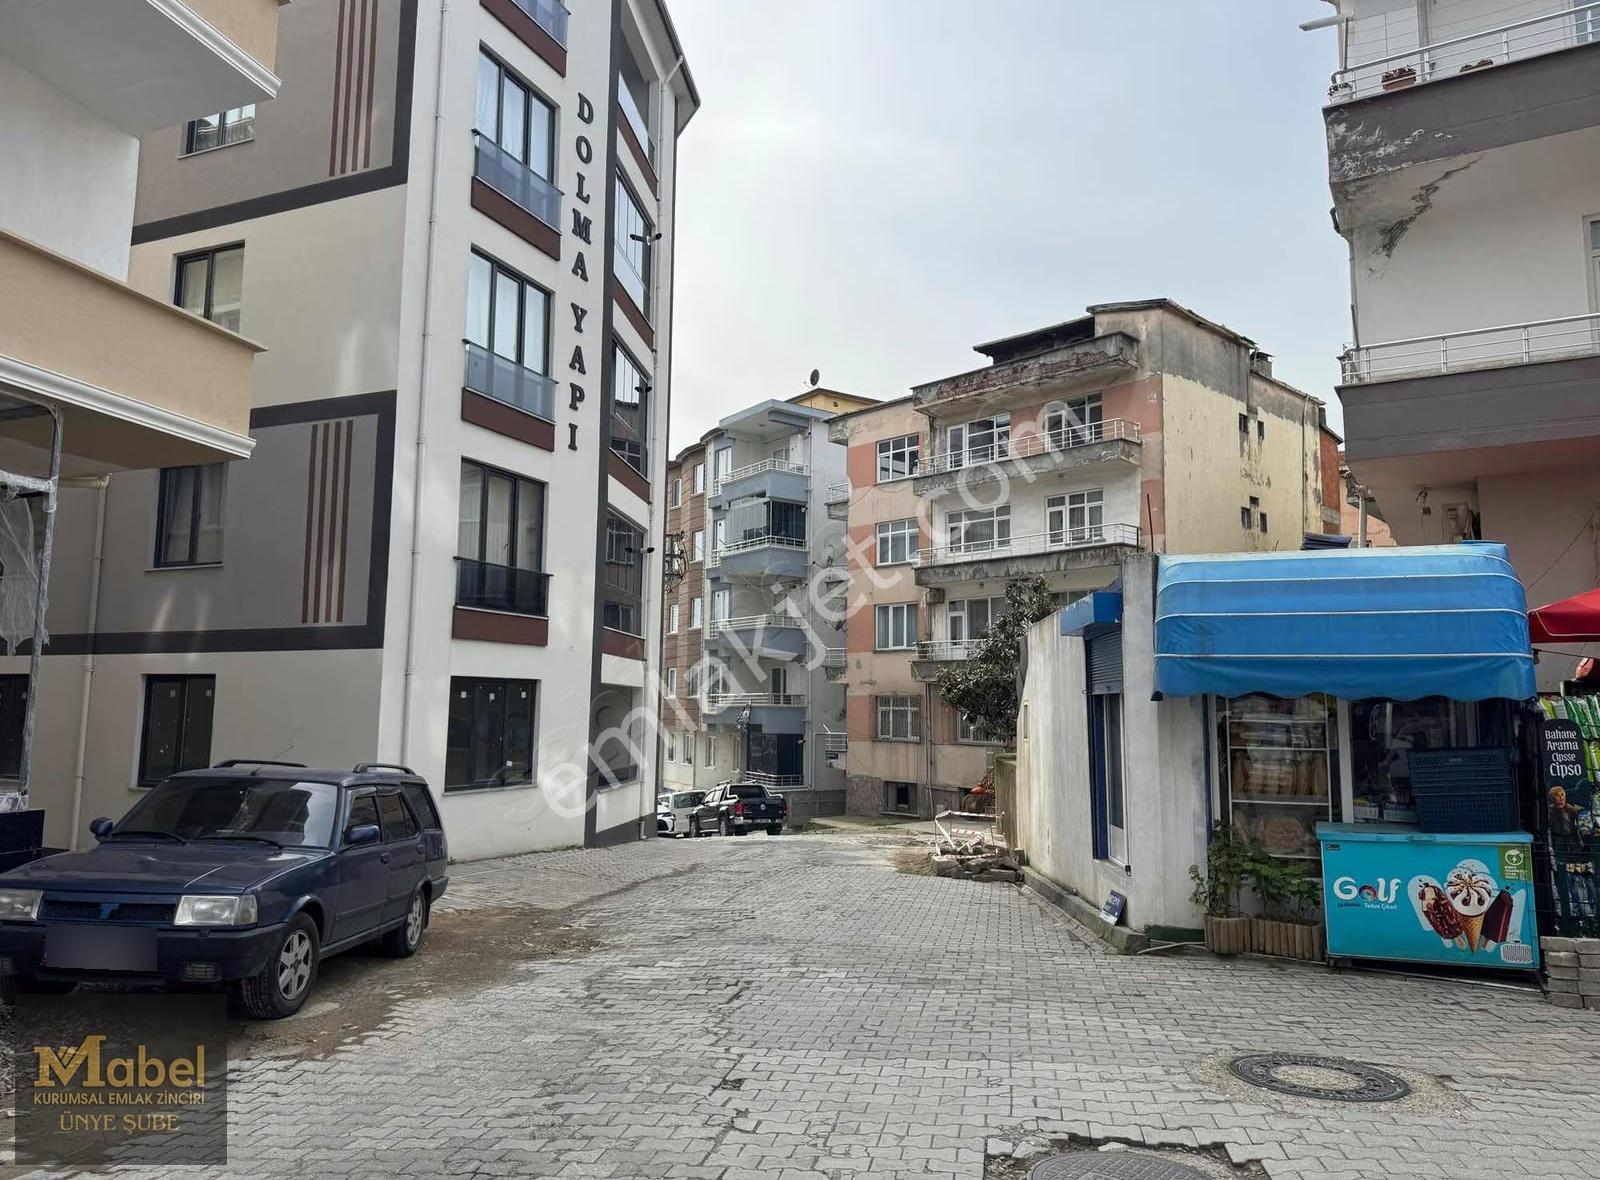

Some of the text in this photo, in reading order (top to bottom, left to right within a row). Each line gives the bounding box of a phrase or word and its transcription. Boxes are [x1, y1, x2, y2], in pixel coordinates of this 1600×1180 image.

[567, 92, 594, 451] DOLMA YAPI
[1545, 730, 1577, 740] Bahane
[1547, 740, 1579, 751] Arama
[1551, 751, 1576, 762] Cipsse
[1549, 761, 1582, 778] Cipso
[1333, 876, 1402, 904] Golf
